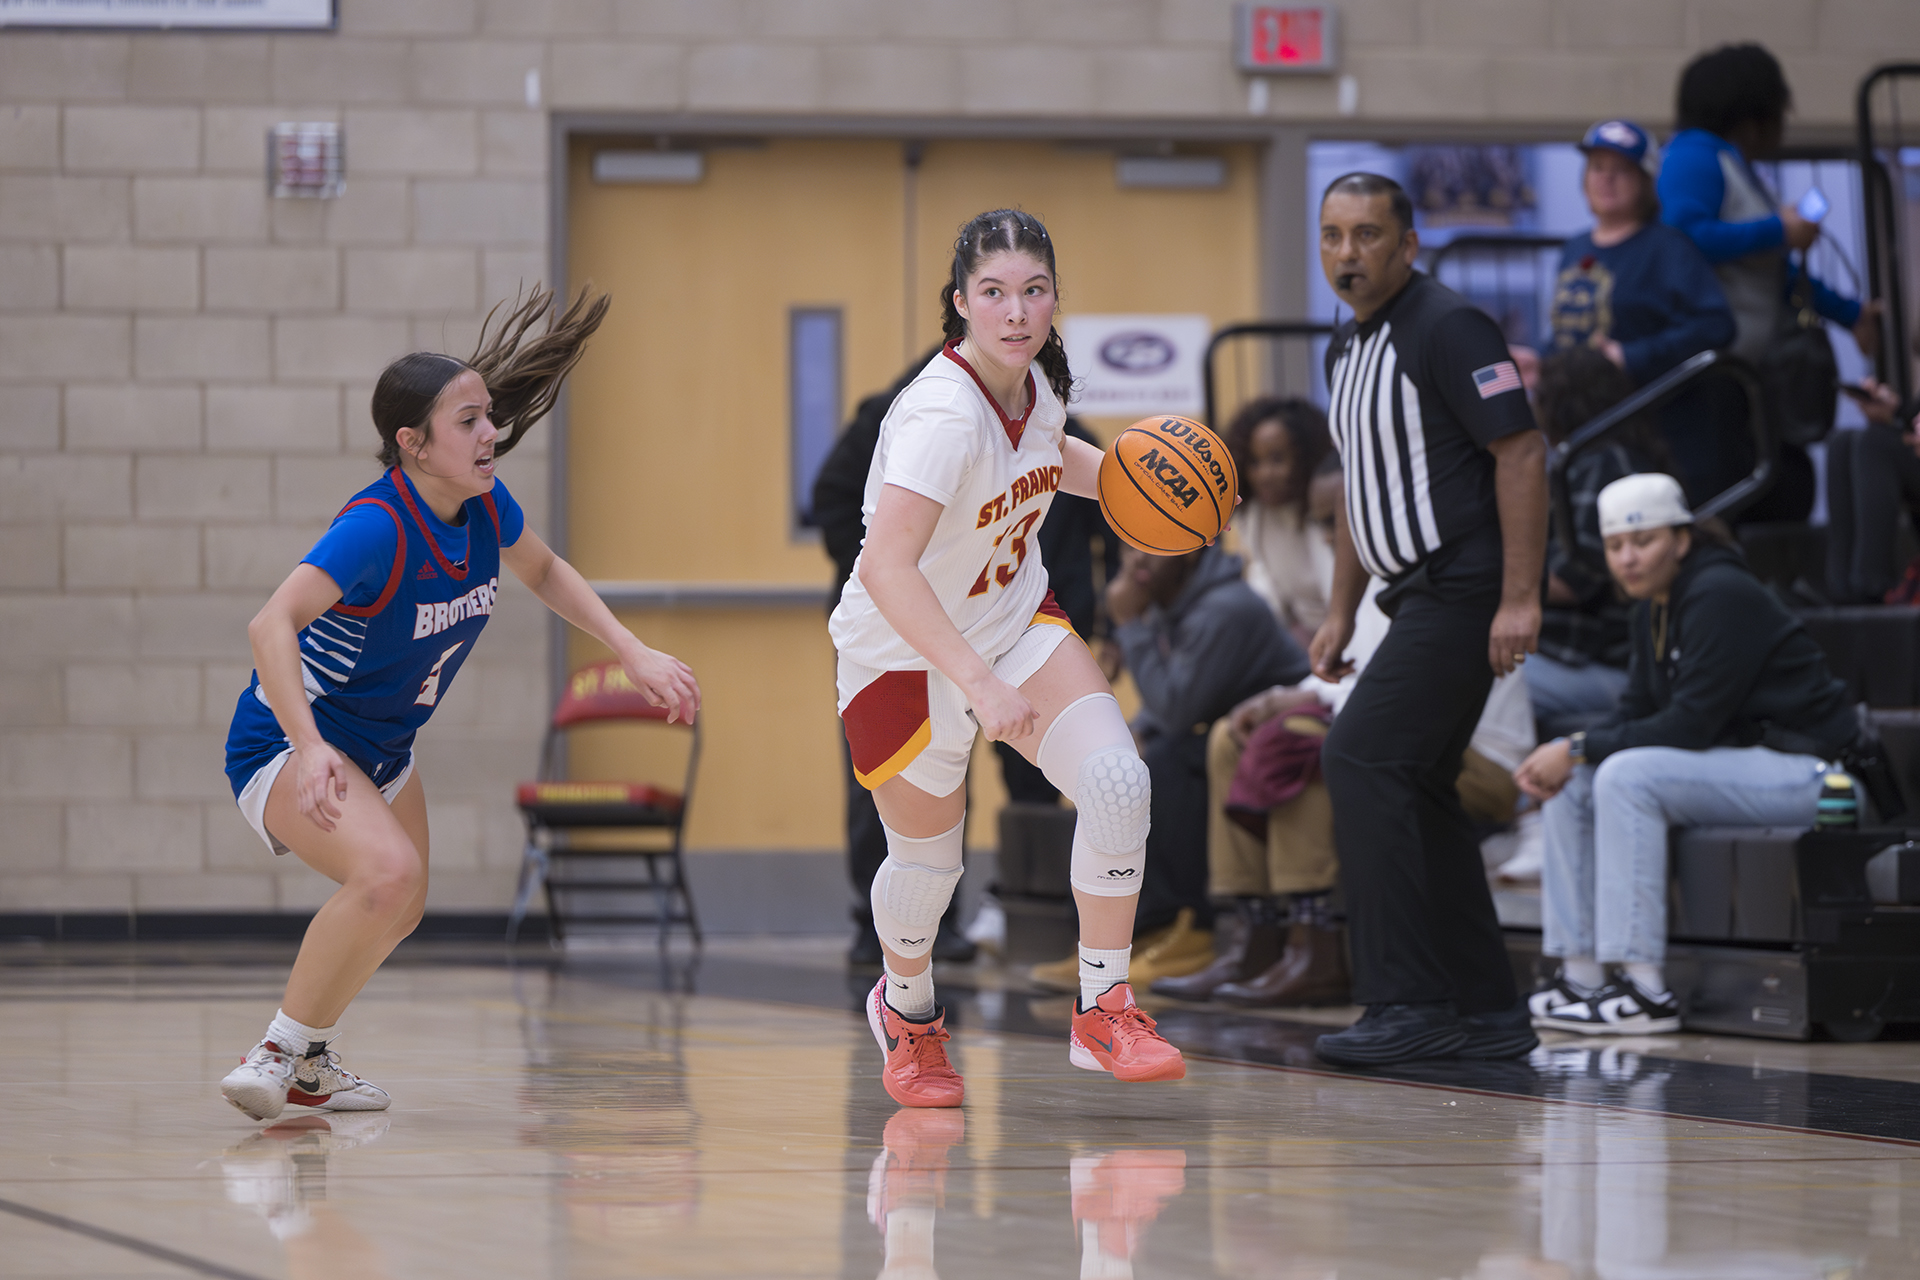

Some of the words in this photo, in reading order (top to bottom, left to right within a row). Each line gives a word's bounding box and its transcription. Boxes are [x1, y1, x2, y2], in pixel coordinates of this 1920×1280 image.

[1138, 448, 1200, 509] NCAA
[1159, 419, 1229, 497] Wilson
[975, 490, 1009, 530] ST.
[966, 507, 1042, 600] 13
